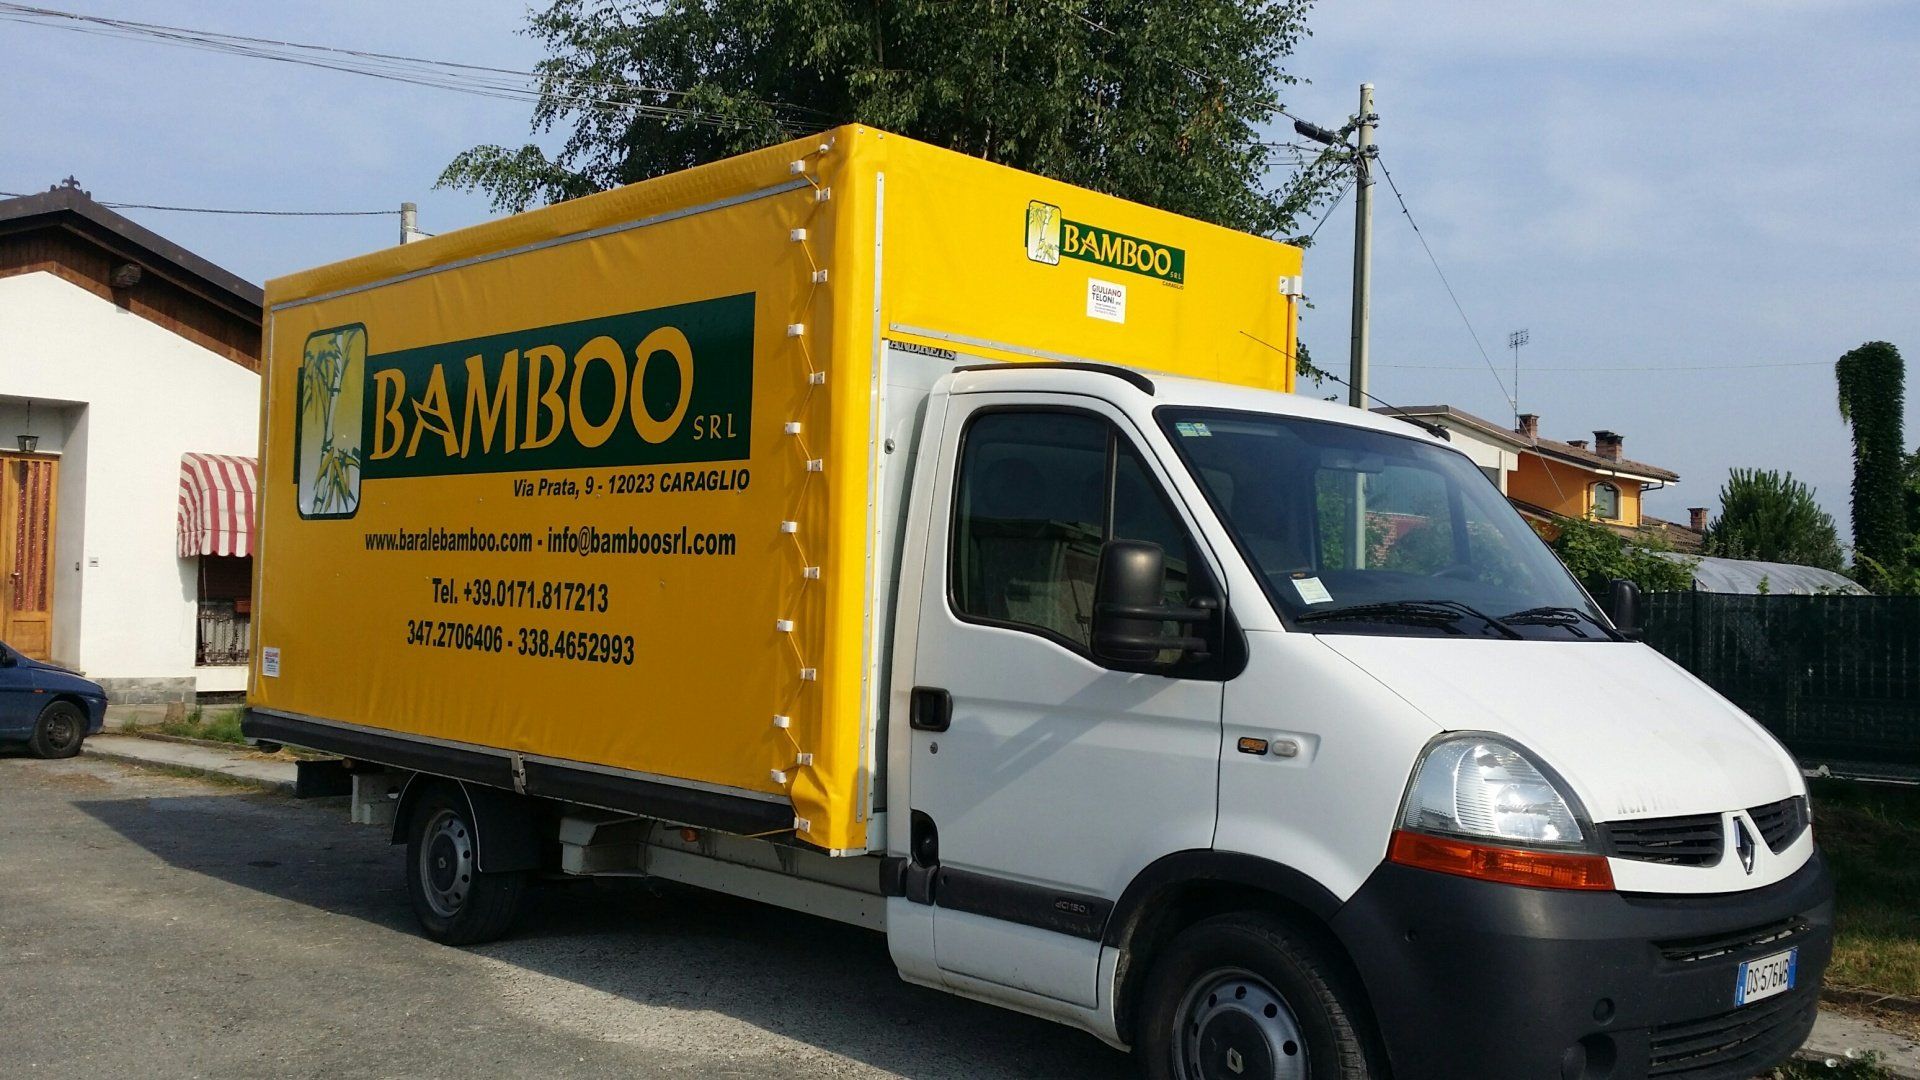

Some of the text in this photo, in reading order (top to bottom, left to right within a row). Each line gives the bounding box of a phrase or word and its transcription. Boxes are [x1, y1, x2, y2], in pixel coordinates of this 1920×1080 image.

[1064, 224, 1172, 275] BAMBOO
[1092, 284, 1122, 298] GIULIANO
[1092, 292, 1115, 305] TELONI
[370, 326, 694, 461] BAMBOO
[693, 412, 737, 441] SRL
[513, 479, 534, 497] Via
[538, 478, 579, 499] Prata,
[585, 476, 594, 495] 9
[608, 473, 654, 494] 12023
[660, 468, 750, 493] CARAGLIO
[365, 527, 532, 552] www.baralebamboo.com
[547, 526, 736, 556] info@bamboosrl.com
[432, 577, 608, 613] Tel. +39.0171.817213
[407, 619, 503, 653] 347.2706406
[518, 627, 635, 665] 338.4652993
